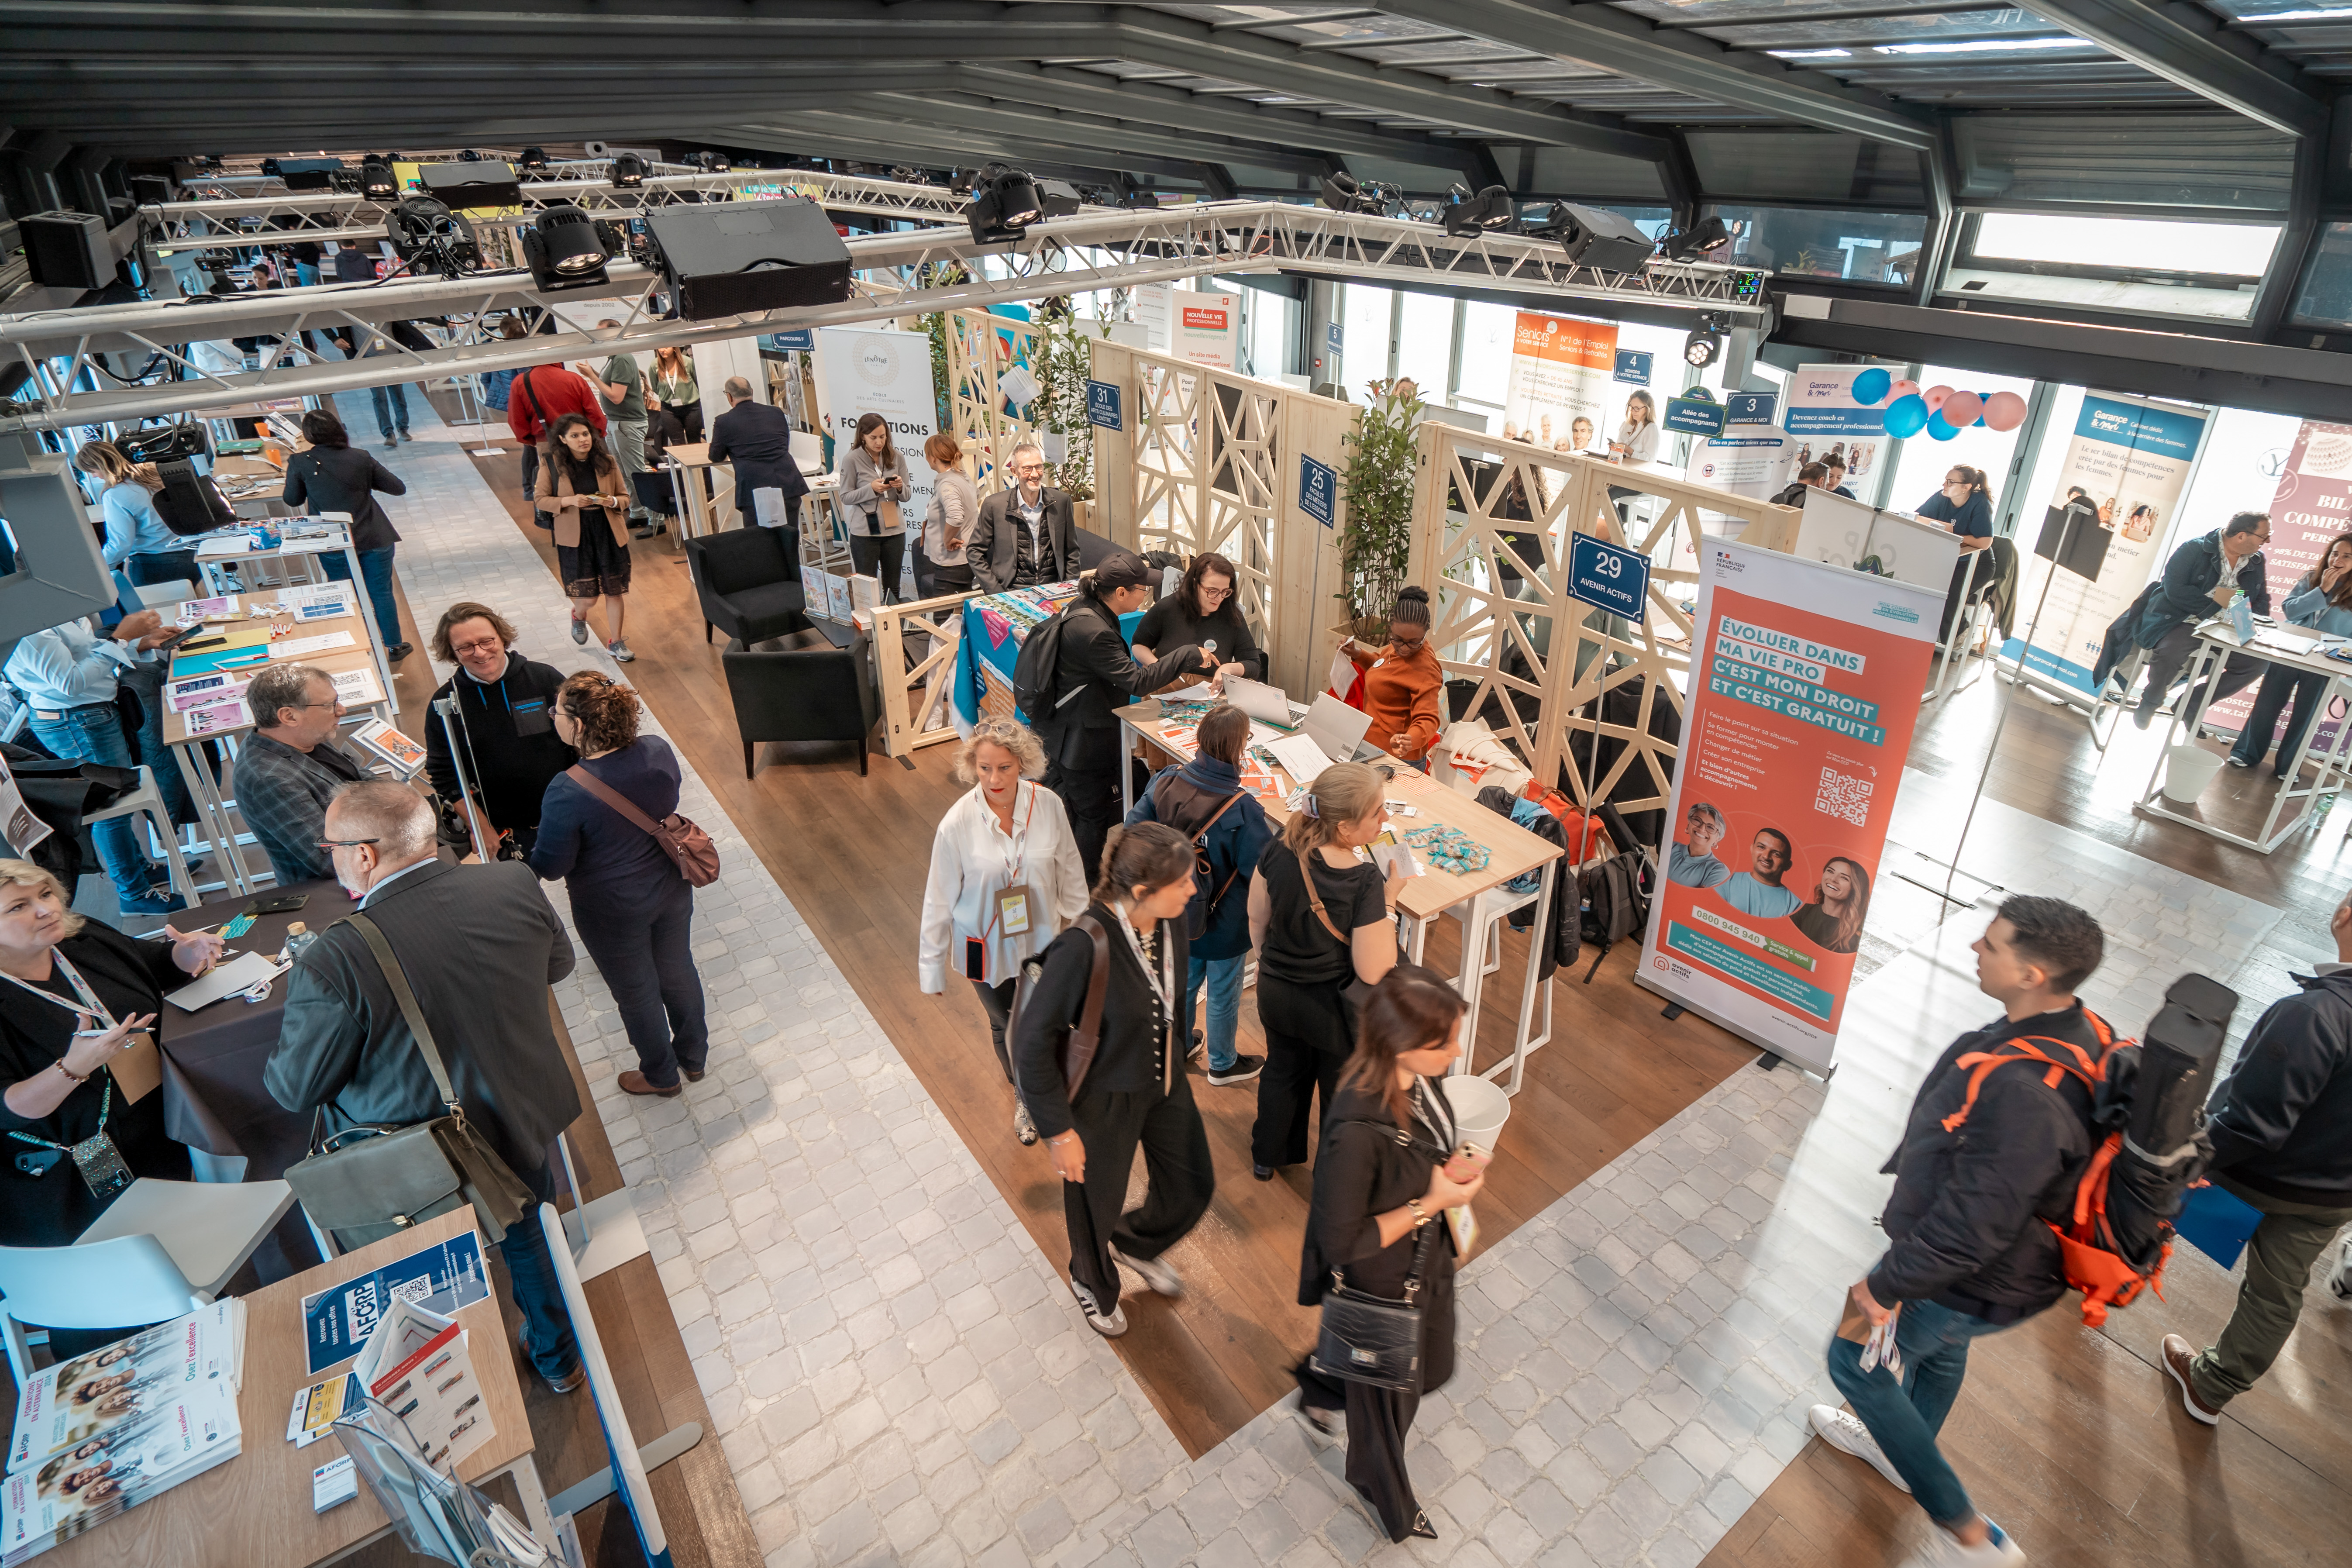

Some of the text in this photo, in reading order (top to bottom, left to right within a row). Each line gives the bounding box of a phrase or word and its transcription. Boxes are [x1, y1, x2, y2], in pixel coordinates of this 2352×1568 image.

[1187, 309, 1212, 319] NOUVELLE
[1184, 332, 1227, 341] nouvelleviepro.fr
[1334, 328, 1337, 339] 5
[1517, 325, 1550, 342] Seniors
[1559, 344, 1577, 353] Seniors
[1584, 348, 1608, 358] Retraités
[1583, 339, 1608, 350] l'Emploi
[864, 355, 888, 365] LENÔTRE
[1630, 355, 1637, 367] 4
[1519, 359, 1601, 379] WWW.SENIORSAVOTRESERVICE.COM
[1097, 387, 1108, 403] 31
[1815, 389, 1831, 397] moi
[1095, 402, 1105, 410] ÉCOLE
[1747, 398, 1756, 412] 3
[1097, 414, 1111, 424] LENÔTRE
[1099, 410, 1118, 418] CULINAIRES
[1682, 409, 1709, 418] Allée des
[2094, 410, 2128, 424] Garance
[841, 417, 929, 436] FOTIONS
[1670, 416, 1718, 427] accompagnants
[2091, 418, 2119, 431] & moi
[2131, 422, 2149, 431] Cabinet
[2102, 448, 2118, 459] bilan
[2129, 458, 2175, 473] compétences
[1312, 468, 1323, 489] 25
[2086, 465, 2113, 478] femmes.
[1310, 486, 1324, 500] FACULTÉ
[1310, 501, 1327, 518] L'ESSONNE
[1313, 496, 1327, 510] MÉTIERS
[2316, 495, 2352, 510] BIL
[2118, 546, 2140, 557] métier
[2292, 550, 2306, 558] DE
[1595, 551, 1622, 579] 29
[1716, 563, 1742, 572] FRANÇAISE
[1717, 558, 1746, 569] RÉPUBLIQUE
[2269, 558, 2318, 572] SATISFAC
[1580, 577, 1632, 603] AVENIR ACTIFS
[1873, 610, 1917, 623] PROFESSIONNELLE
[1890, 609, 1918, 618] ÉVOLUTION
[1721, 618, 1860, 671] ÉVOLUER DANS
[1718, 639, 1819, 680] MA VIE PRO
[2026, 652, 2078, 678] ww.garance-et-moi.com
[1714, 659, 1874, 719] C'EST MON DROIT
[1711, 678, 1880, 743] ET C'EST GRATUIT !
[1709, 711, 1724, 722] Faire
[1732, 718, 1750, 731] point
[1770, 731, 1798, 746] situation
[1715, 731, 1757, 750] compétences
[1705, 739, 1762, 763] Changer de métier
[1700, 766, 1757, 791] accompagnements
[1696, 910, 1760, 944] 0800 945 940
[1768, 947, 1789, 958] gratuits
[1770, 941, 1789, 953] Service
[1794, 952, 1809, 963] appel
[1671, 968, 1690, 979] actifs
[1672, 963, 1692, 975] avenir
[1722, 948, 1739, 959] Avenir
[1740, 955, 1756, 967] Actifs
[1773, 971, 1793, 985] service
[1793, 982, 1811, 993] public
[1771, 1015, 1818, 1039] avenir-actifs.org/IDF
[465, 1255, 475, 1282] Rejoignez-nous
[352, 1284, 378, 1338] AFORP
[185, 1322, 196, 1382] Osez l'excellence
[375, 1358, 414, 1389] REJOIGNEZ-NOUS
[24, 1381, 35, 1417] FORMATIONS
[33, 1377, 43, 1415] ALTERNANCE
[178, 1405, 189, 1437] l'excellence
[21, 1433, 30, 1452] AFORP
[326, 1457, 352, 1472] AFORP
